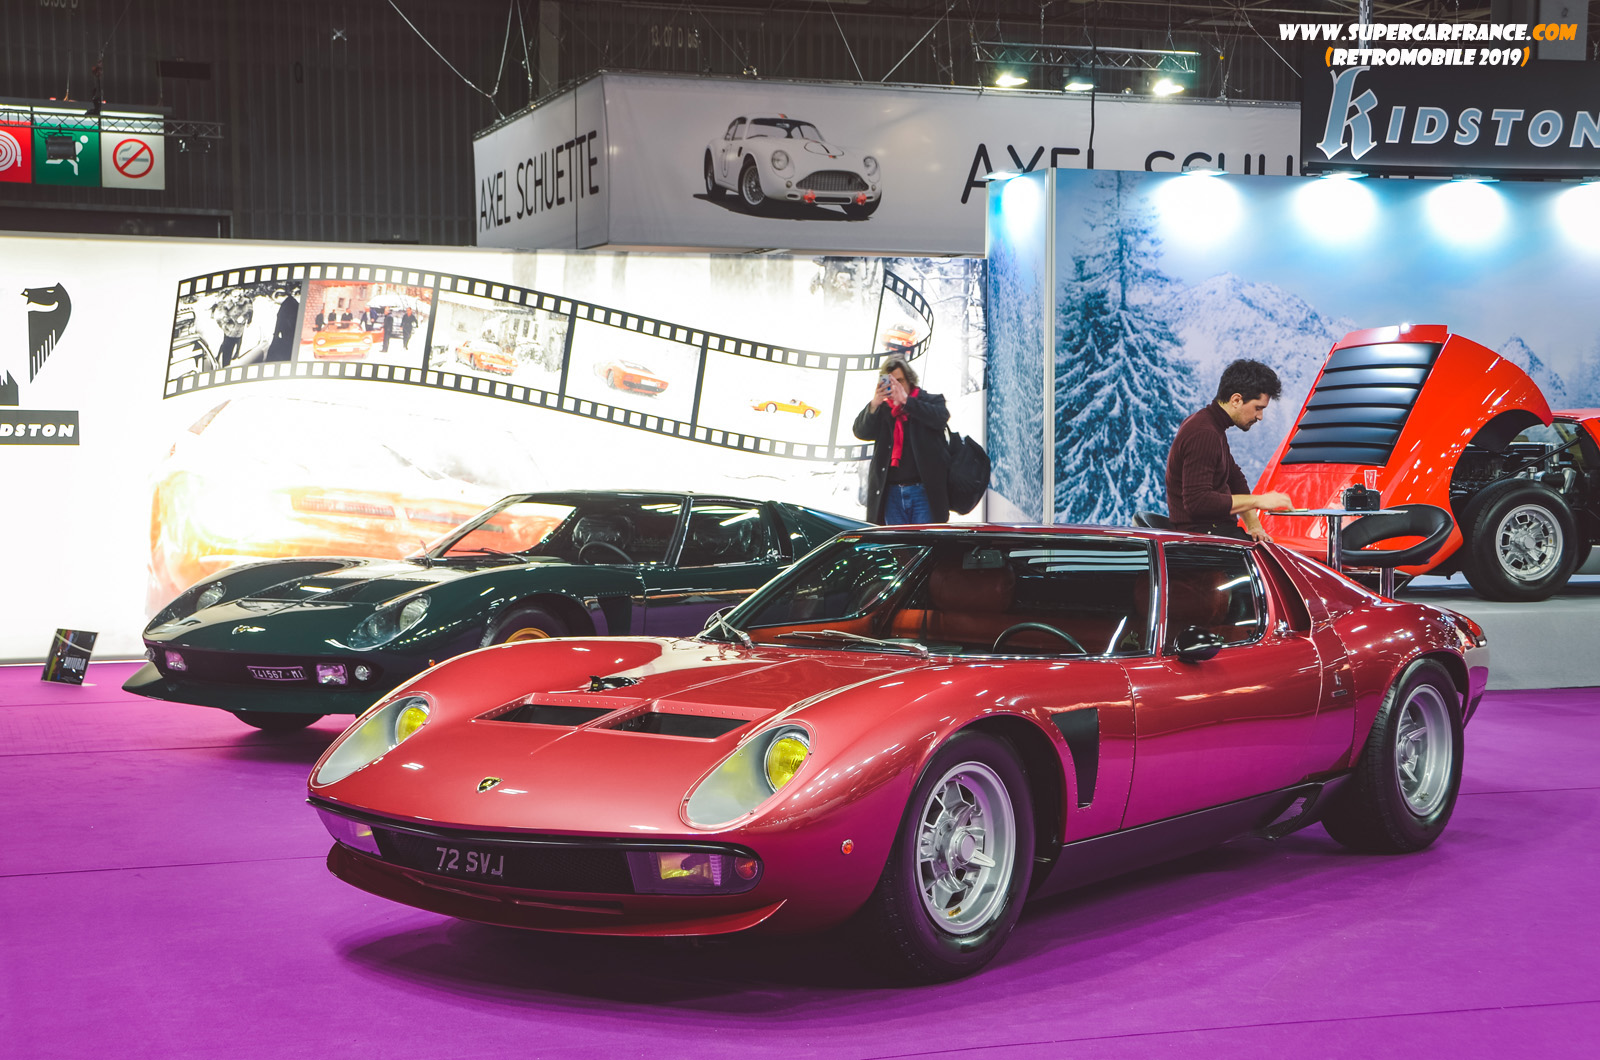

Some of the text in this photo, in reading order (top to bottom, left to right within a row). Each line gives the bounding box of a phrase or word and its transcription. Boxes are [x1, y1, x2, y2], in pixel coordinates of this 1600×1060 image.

[1316, 66, 1600, 160] KIDSTON
[480, 130, 600, 233] AXEL SCHUETTE
[290, 670, 304, 679] MI
[436, 846, 504, 876] 72 SVJ
